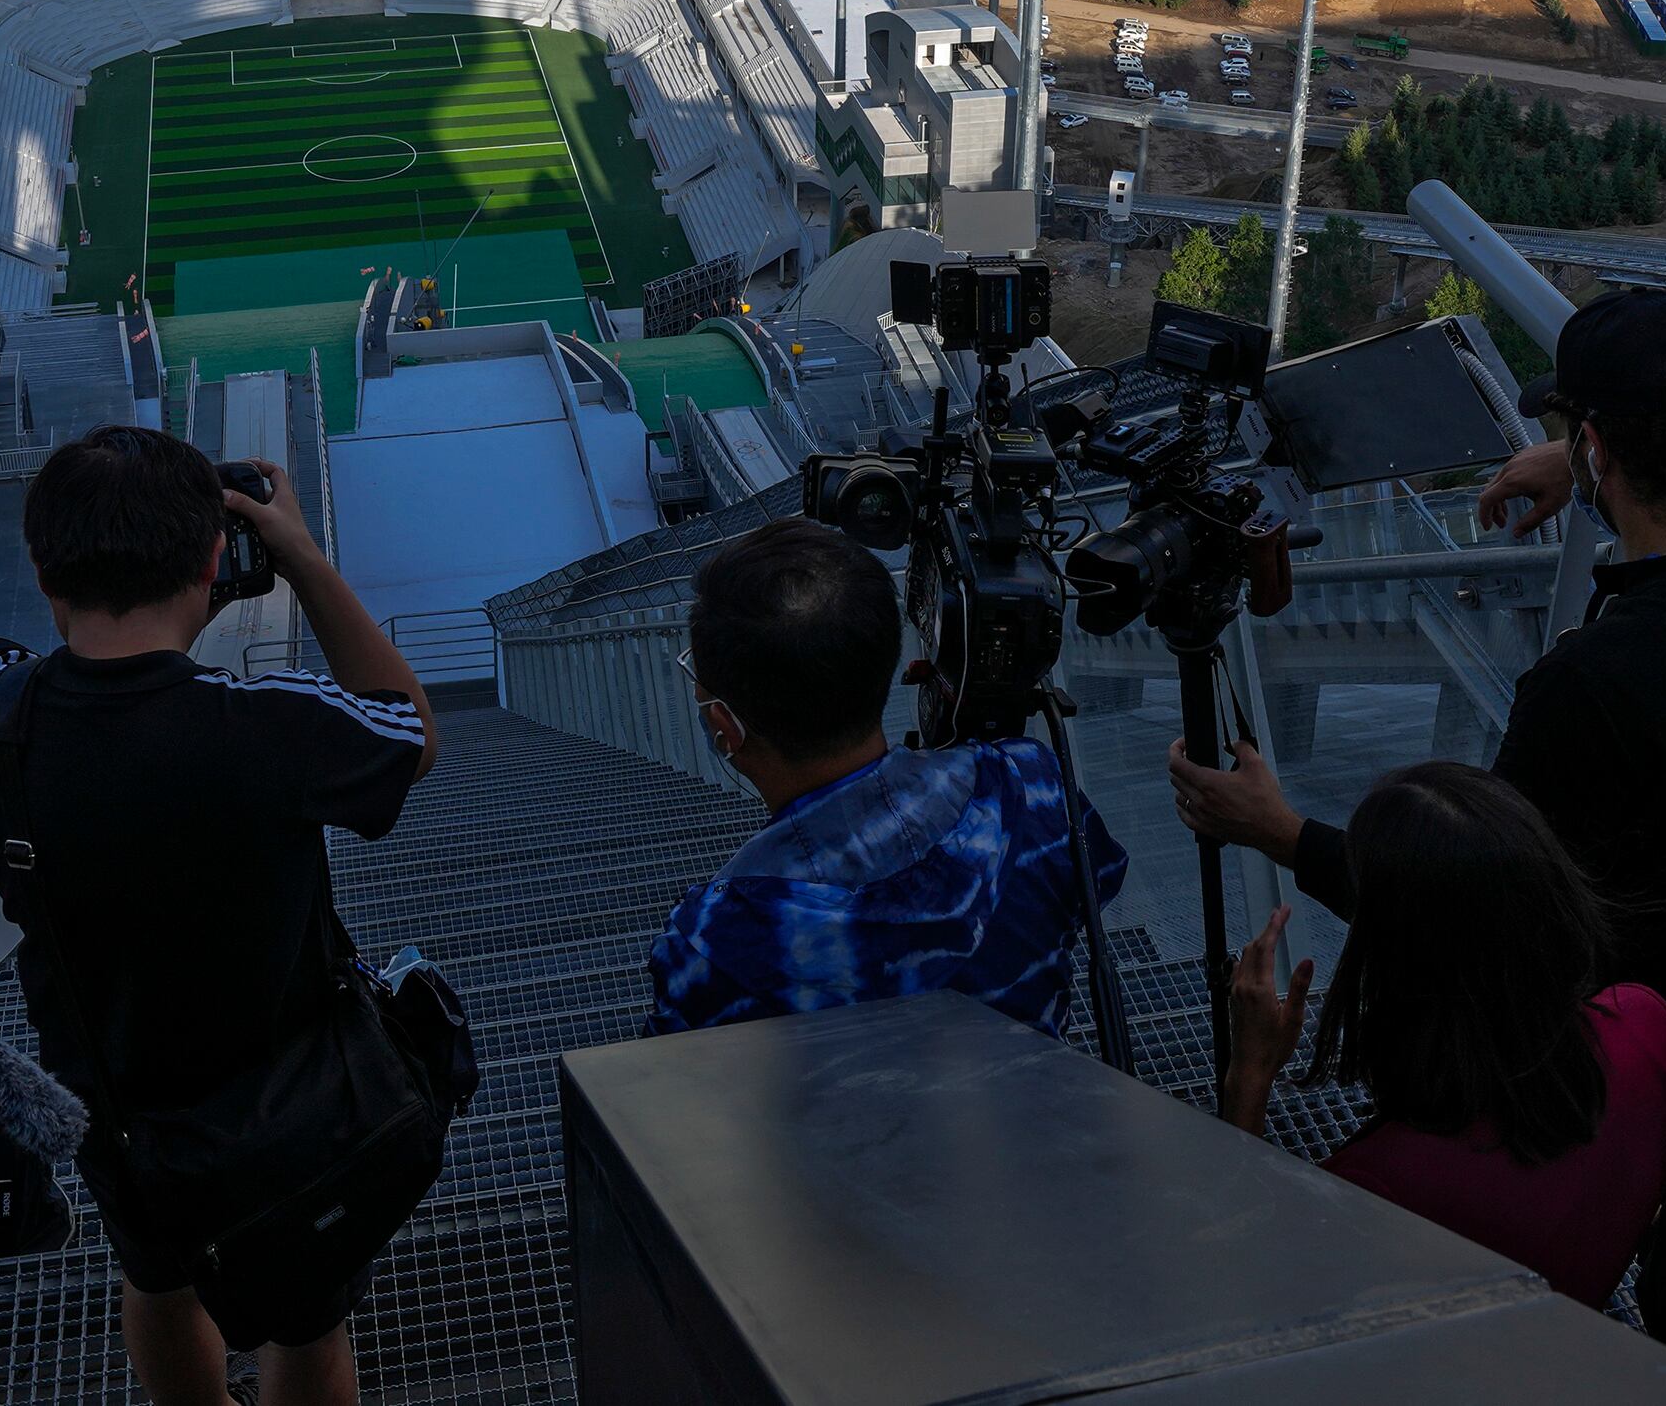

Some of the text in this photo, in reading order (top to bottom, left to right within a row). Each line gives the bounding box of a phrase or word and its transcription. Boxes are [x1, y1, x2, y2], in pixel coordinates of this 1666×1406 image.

[1246, 414, 1260, 436] PHILIPS
[1285, 480, 1300, 502] PHILIPS
[942, 546, 953, 566] SONY
